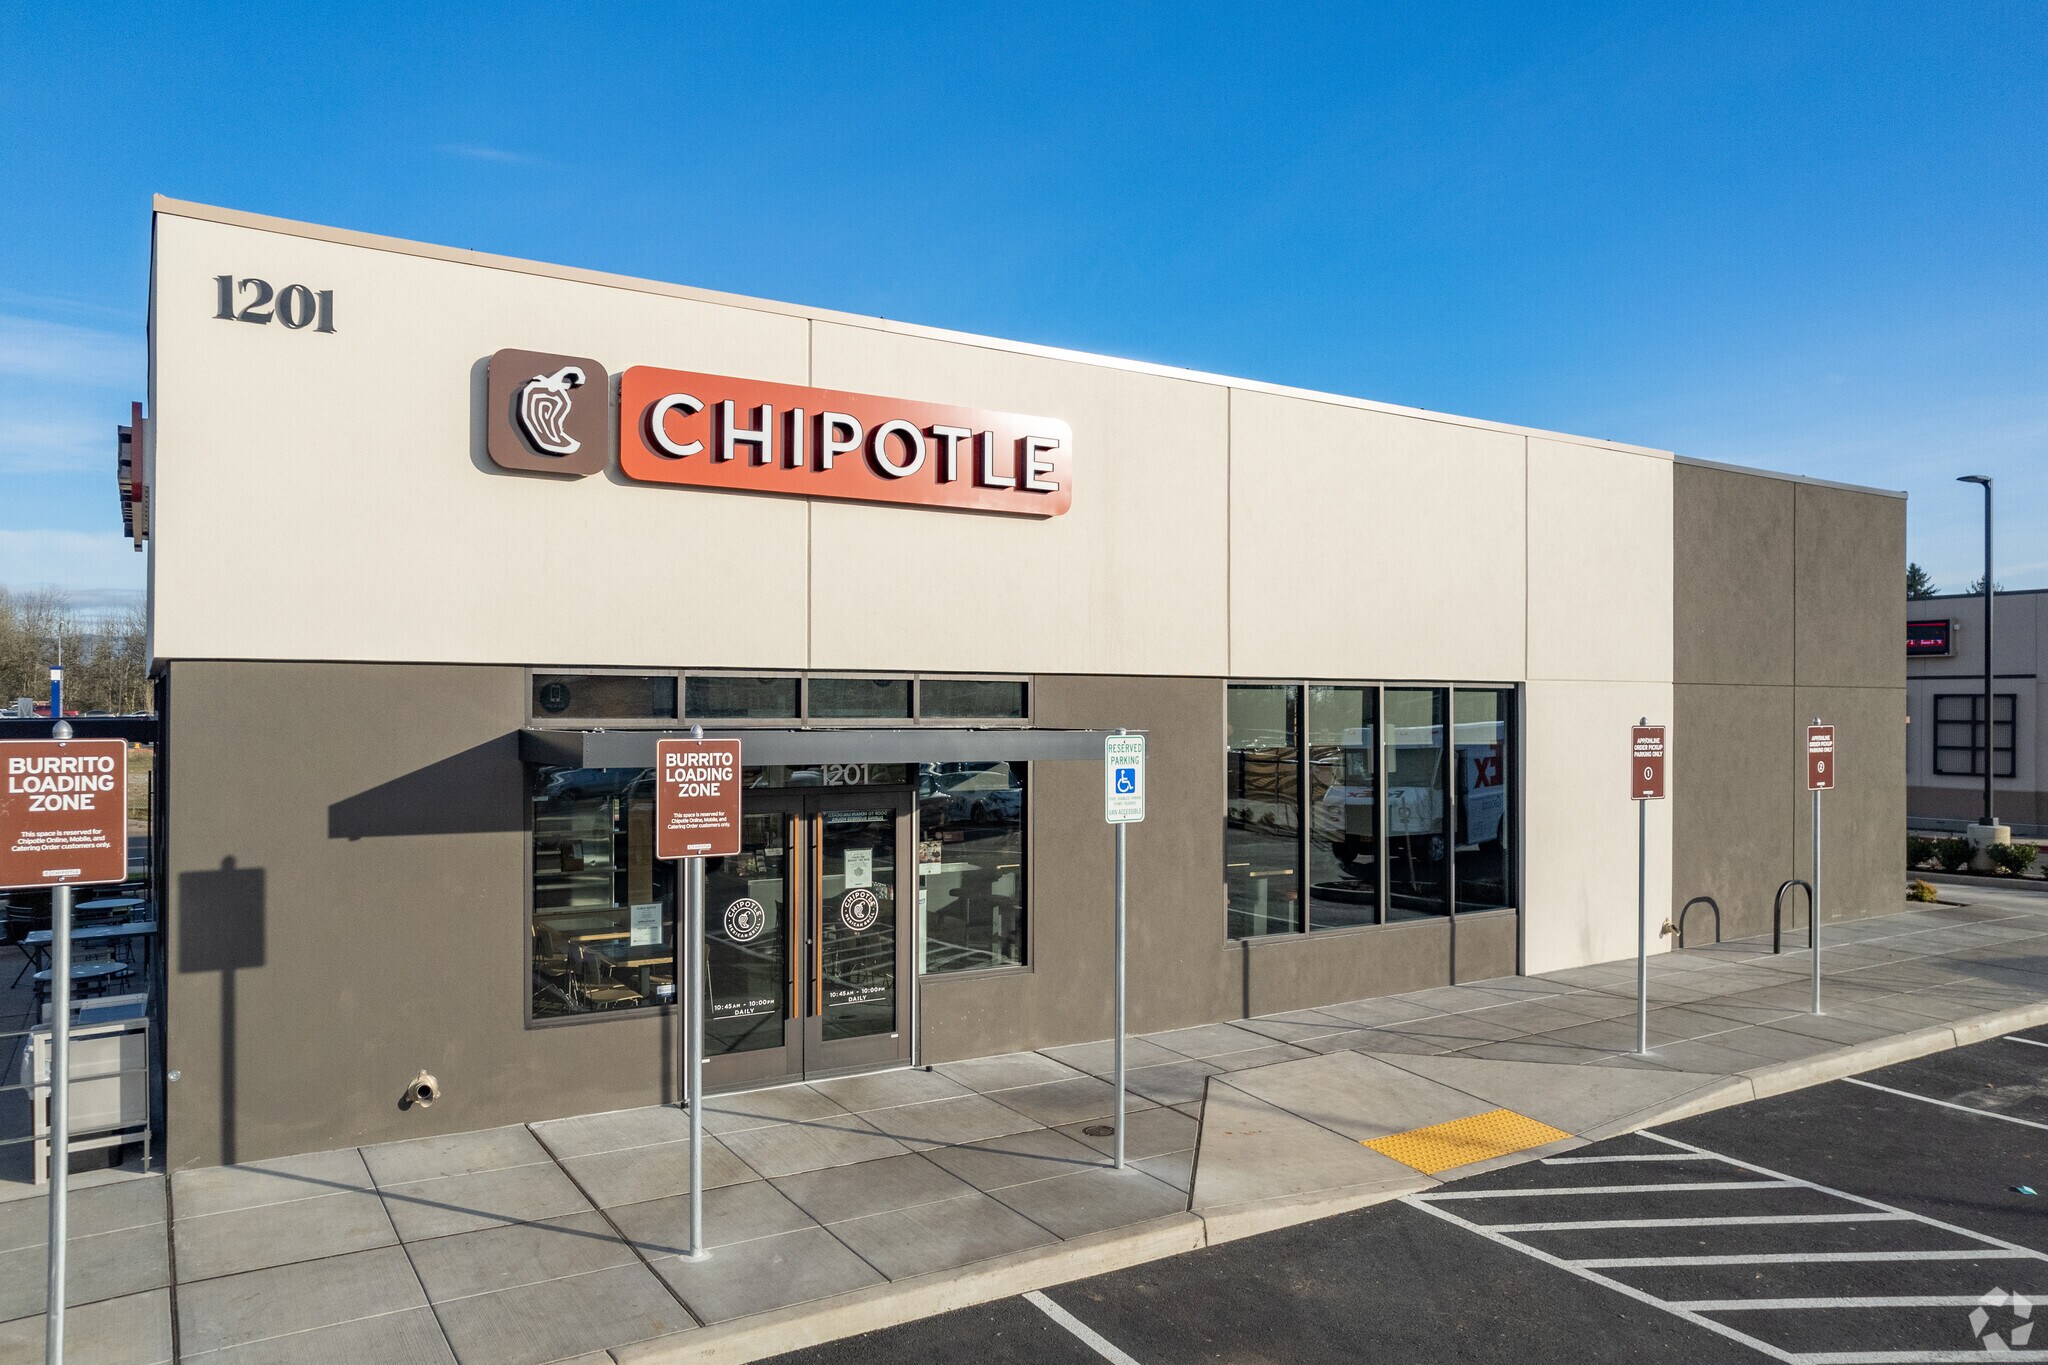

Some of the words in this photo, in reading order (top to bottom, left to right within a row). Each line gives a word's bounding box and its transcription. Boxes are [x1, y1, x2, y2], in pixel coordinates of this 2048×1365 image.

[213, 275, 337, 334] 1201
[648, 393, 1060, 492] CHIPOTLE
[1108, 743, 1142, 753] RESERVED
[9, 756, 115, 774] BURRITO
[666, 752, 733, 767] BURRITO
[1110, 755, 1140, 766] PARKING
[666, 767, 733, 782] LOADING
[820, 763, 869, 786] 1201
[9, 774, 115, 793] LOADING
[678, 782, 721, 797] ZONE
[28, 793, 96, 812] ZONE
[17, 837, 46, 845] Chipotle
[46, 836, 69, 844] Online,
[69, 835, 93, 843] Mobile,
[21, 830, 36, 838] This
[36, 830, 56, 838] space
[63, 828, 92, 836] reserved
[11, 845, 41, 853] Catering
[61, 842, 95, 850] customers
[95, 841, 111, 849] only.
[845, 891, 876, 908] CHIPOTLE
[728, 901, 762, 917] CHIPOTLE
[734, 1008, 755, 1016] DAILY
